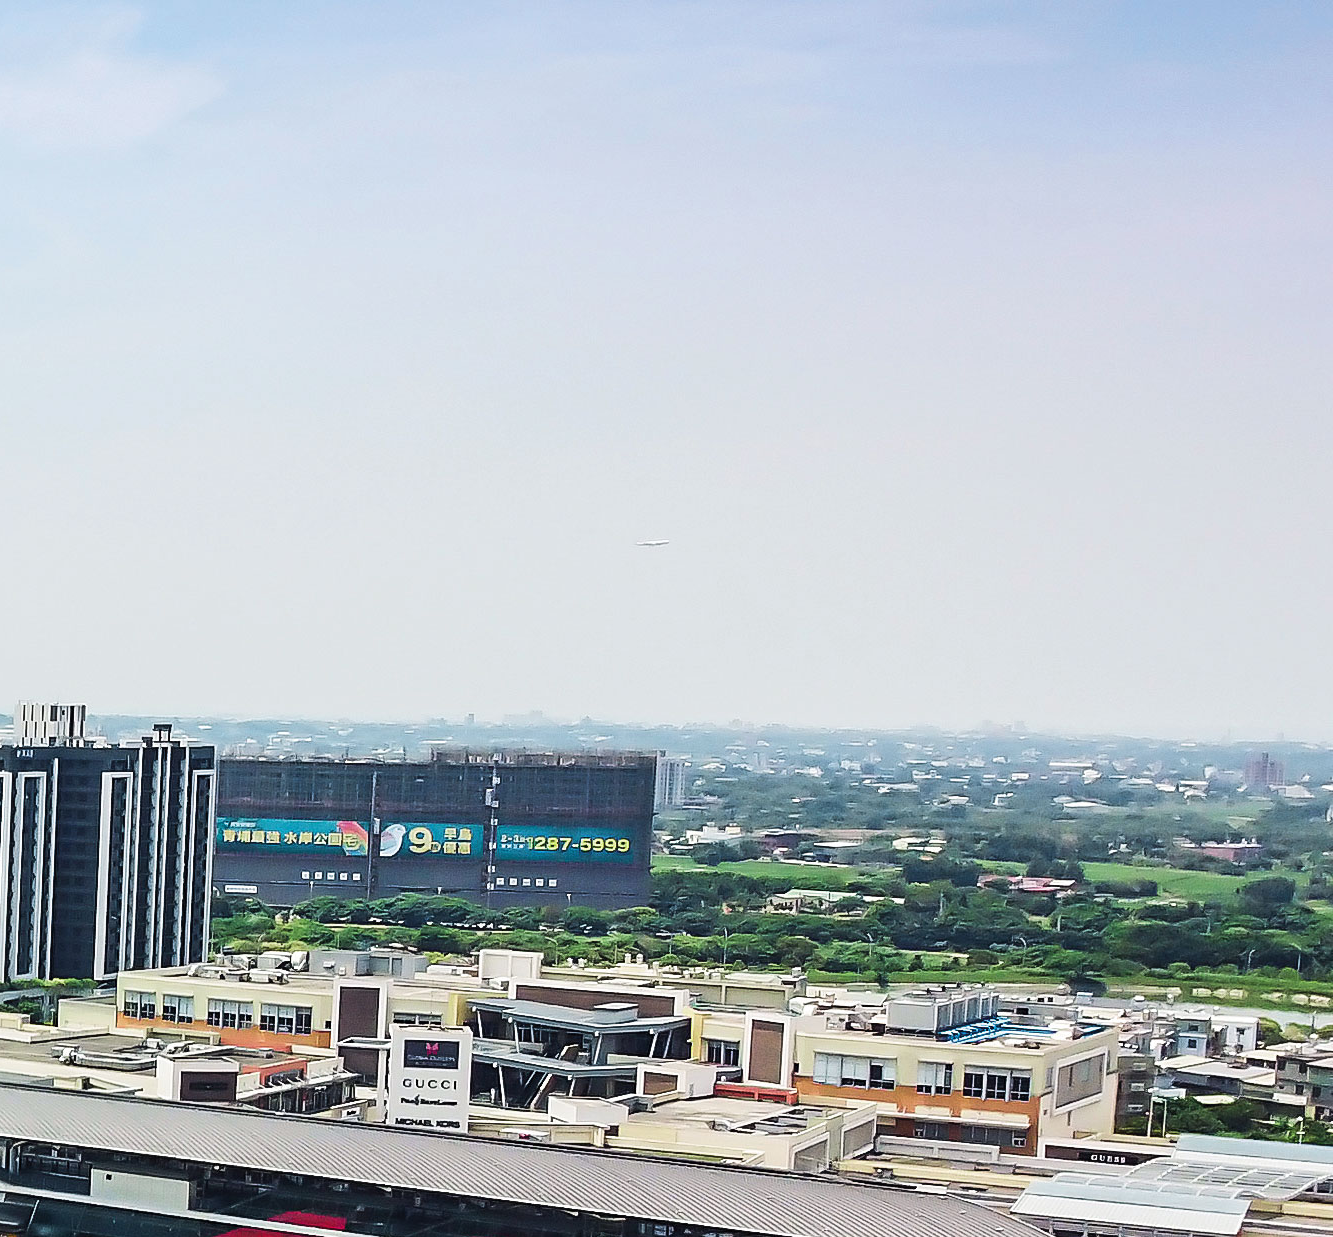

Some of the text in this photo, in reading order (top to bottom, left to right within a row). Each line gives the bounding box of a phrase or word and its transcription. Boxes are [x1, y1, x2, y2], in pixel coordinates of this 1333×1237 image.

[402, 1078, 457, 1090] GUCCI
[395, 1117, 460, 1129] MICHAEL KORS
